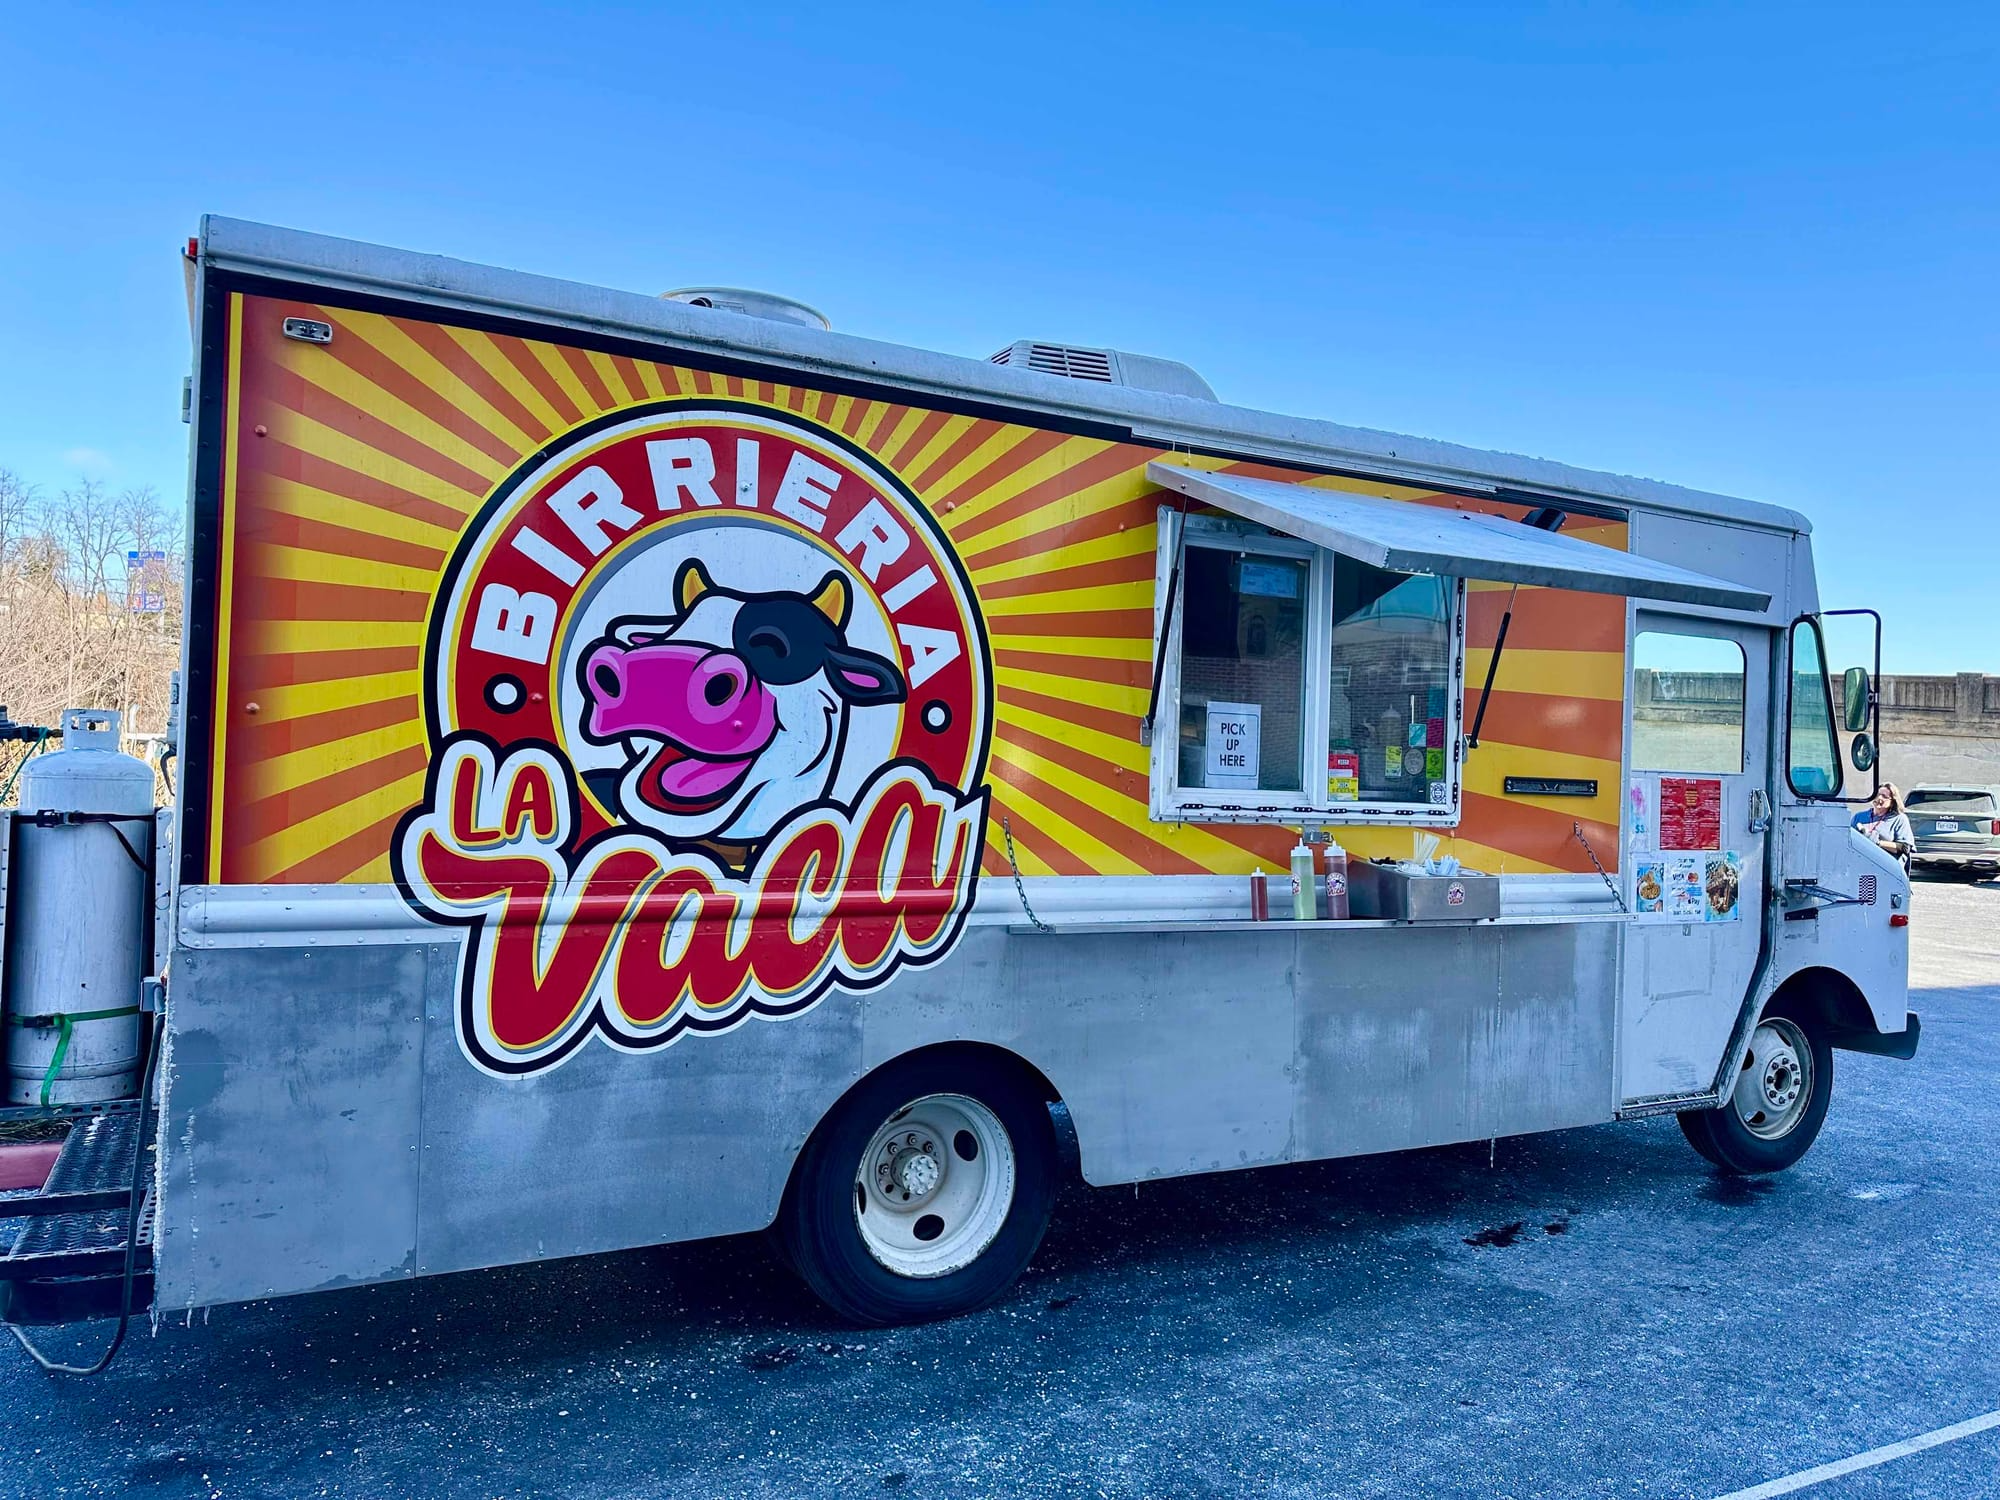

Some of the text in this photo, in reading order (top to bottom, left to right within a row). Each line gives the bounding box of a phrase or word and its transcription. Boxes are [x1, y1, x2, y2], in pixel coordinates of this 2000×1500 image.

[470, 437, 962, 690] BIRRIERIA
[1221, 722, 1246, 736] PICK
[1226, 739, 1239, 751] UP
[1220, 753, 1246, 767] HERE
[450, 753, 557, 847] LA
[419, 777, 971, 1052] Vaca
